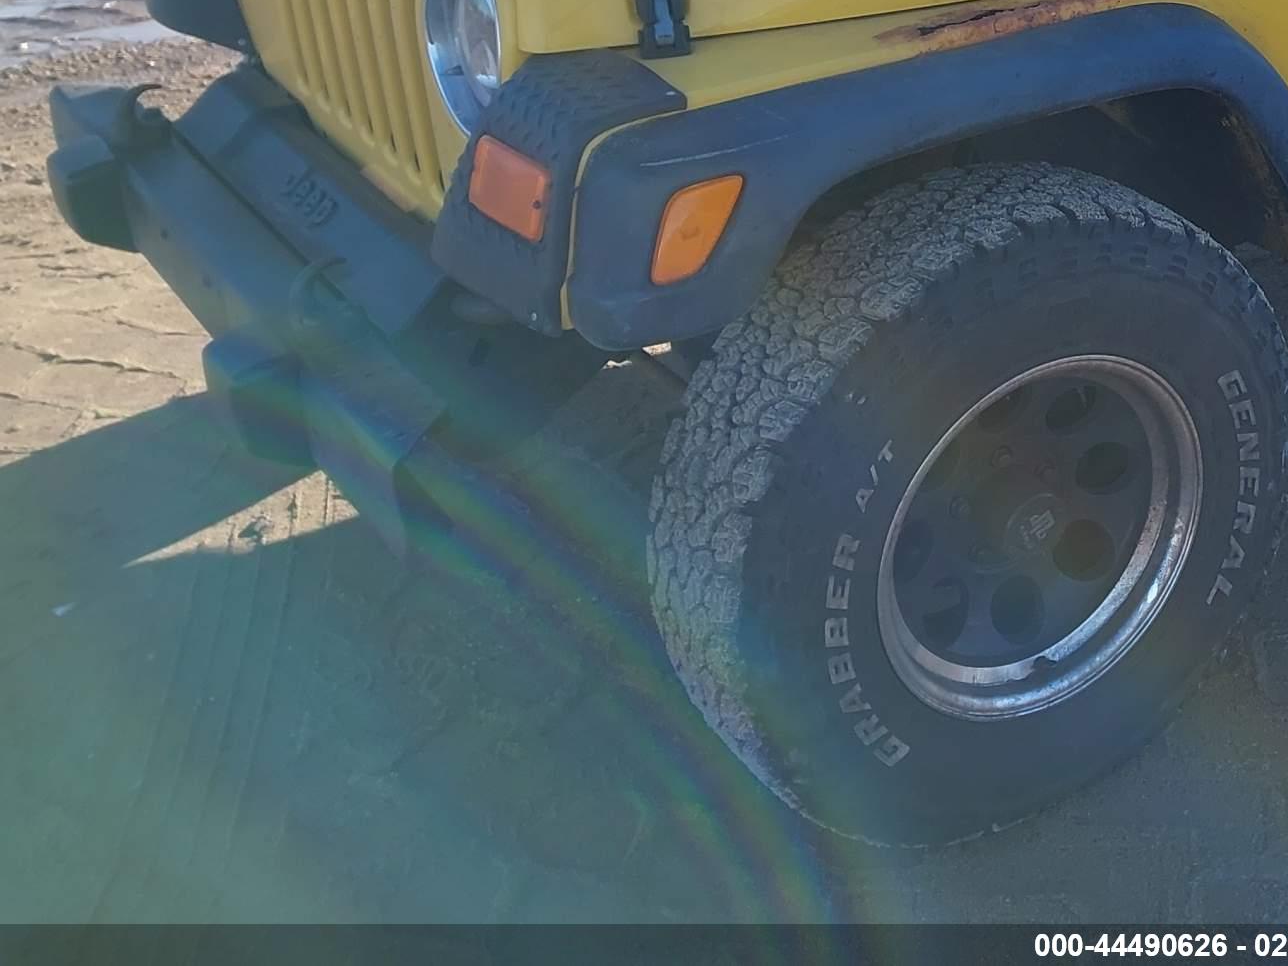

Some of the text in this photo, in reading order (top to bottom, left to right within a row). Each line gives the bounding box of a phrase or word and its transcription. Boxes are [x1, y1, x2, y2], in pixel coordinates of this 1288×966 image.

[280, 171, 339, 229] Jeep
[824, 439, 910, 767] GRABBER A/T
[1205, 369, 1261, 605] GENERAL
